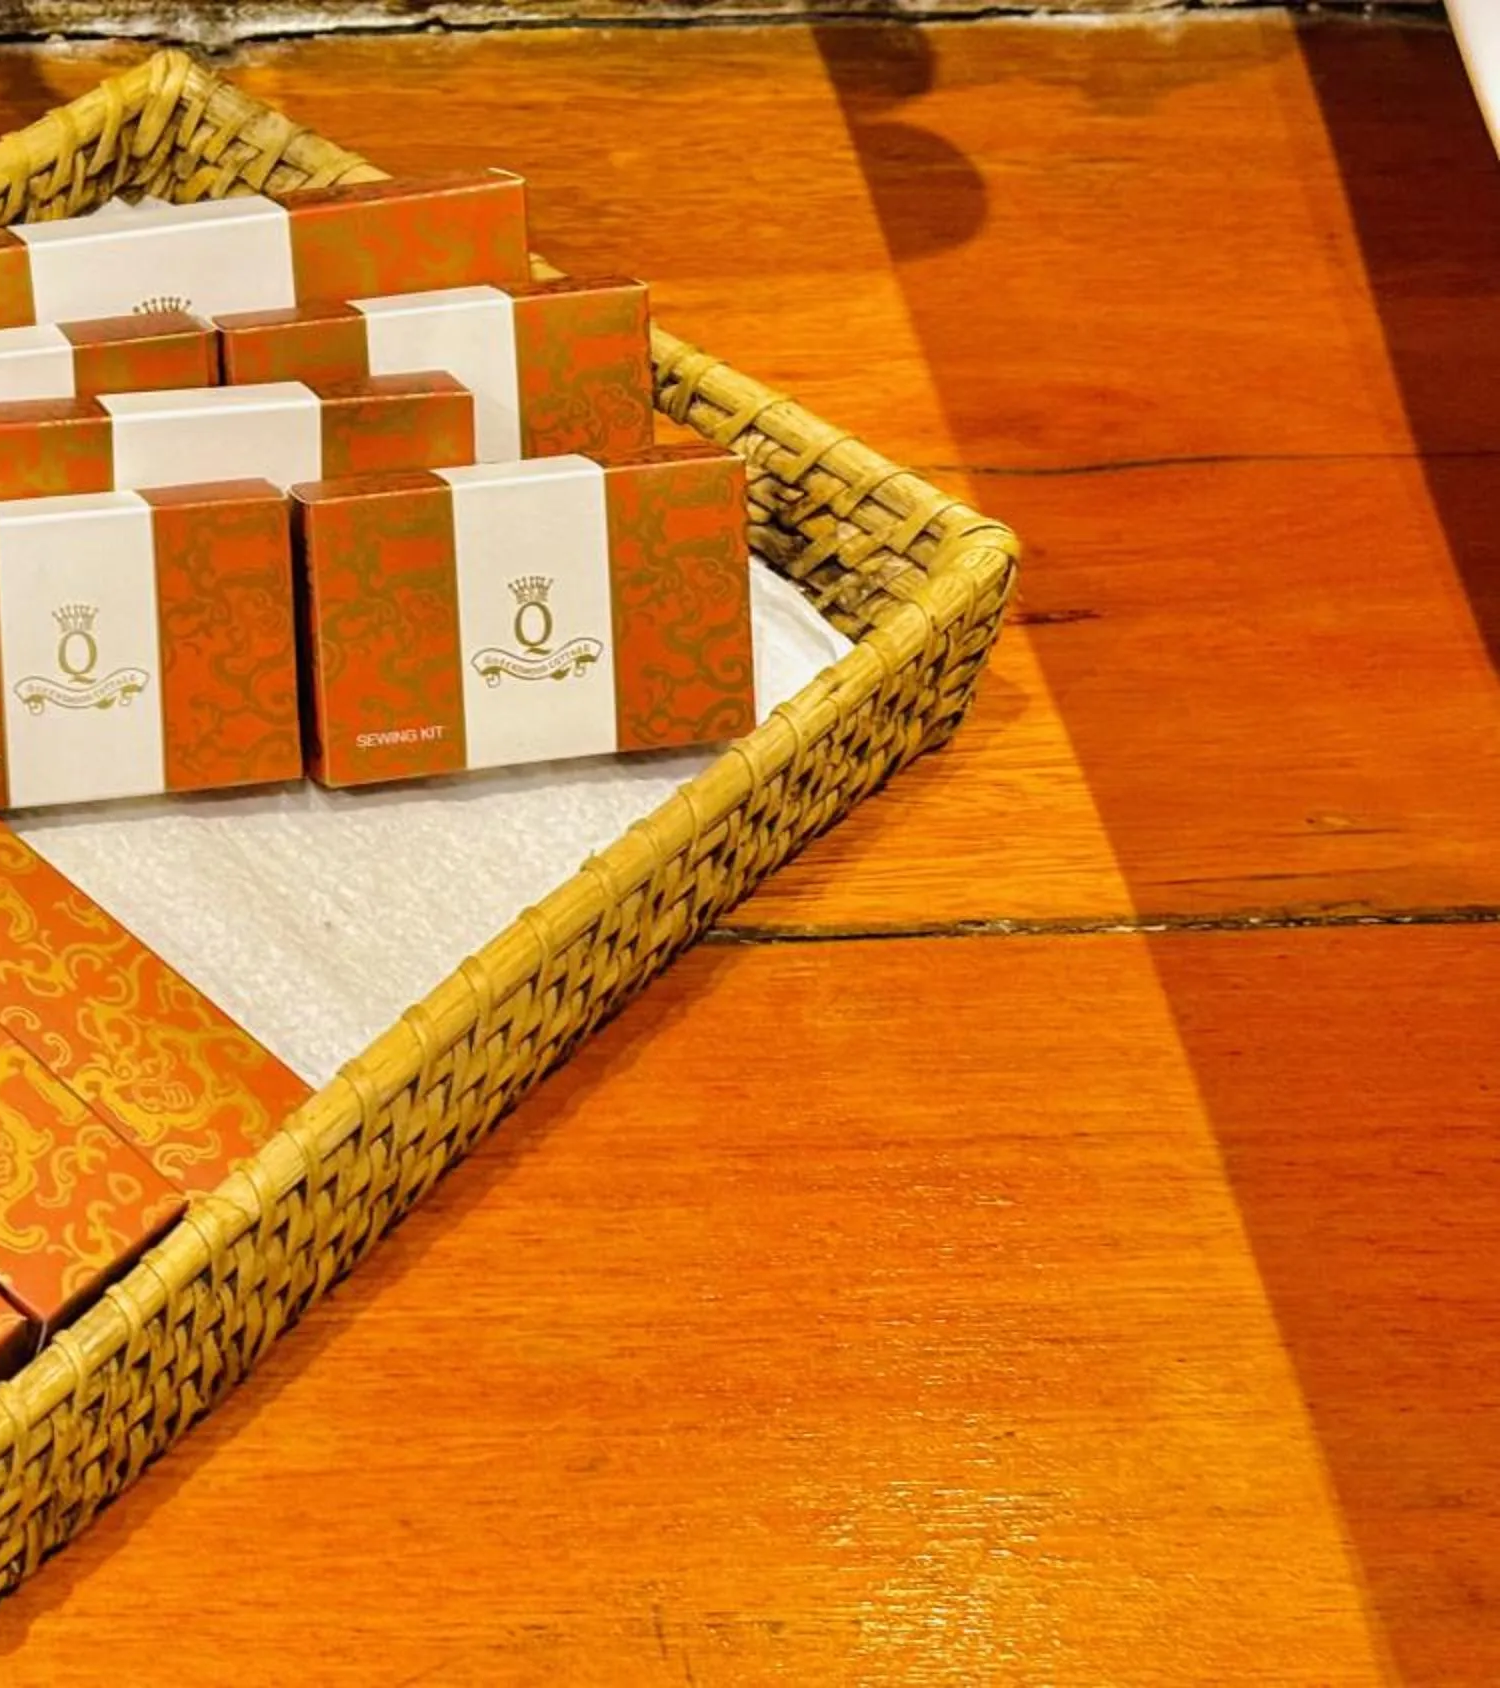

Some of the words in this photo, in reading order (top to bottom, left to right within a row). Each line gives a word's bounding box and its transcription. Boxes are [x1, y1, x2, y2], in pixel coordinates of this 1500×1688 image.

[514, 601, 552, 655] Q
[57, 630, 98, 685] Q
[548, 643, 591, 669] COTTAGE
[94, 673, 137, 698] COTTAGE
[355, 729, 418, 748] SEWING
[420, 725, 444, 741] KIT
